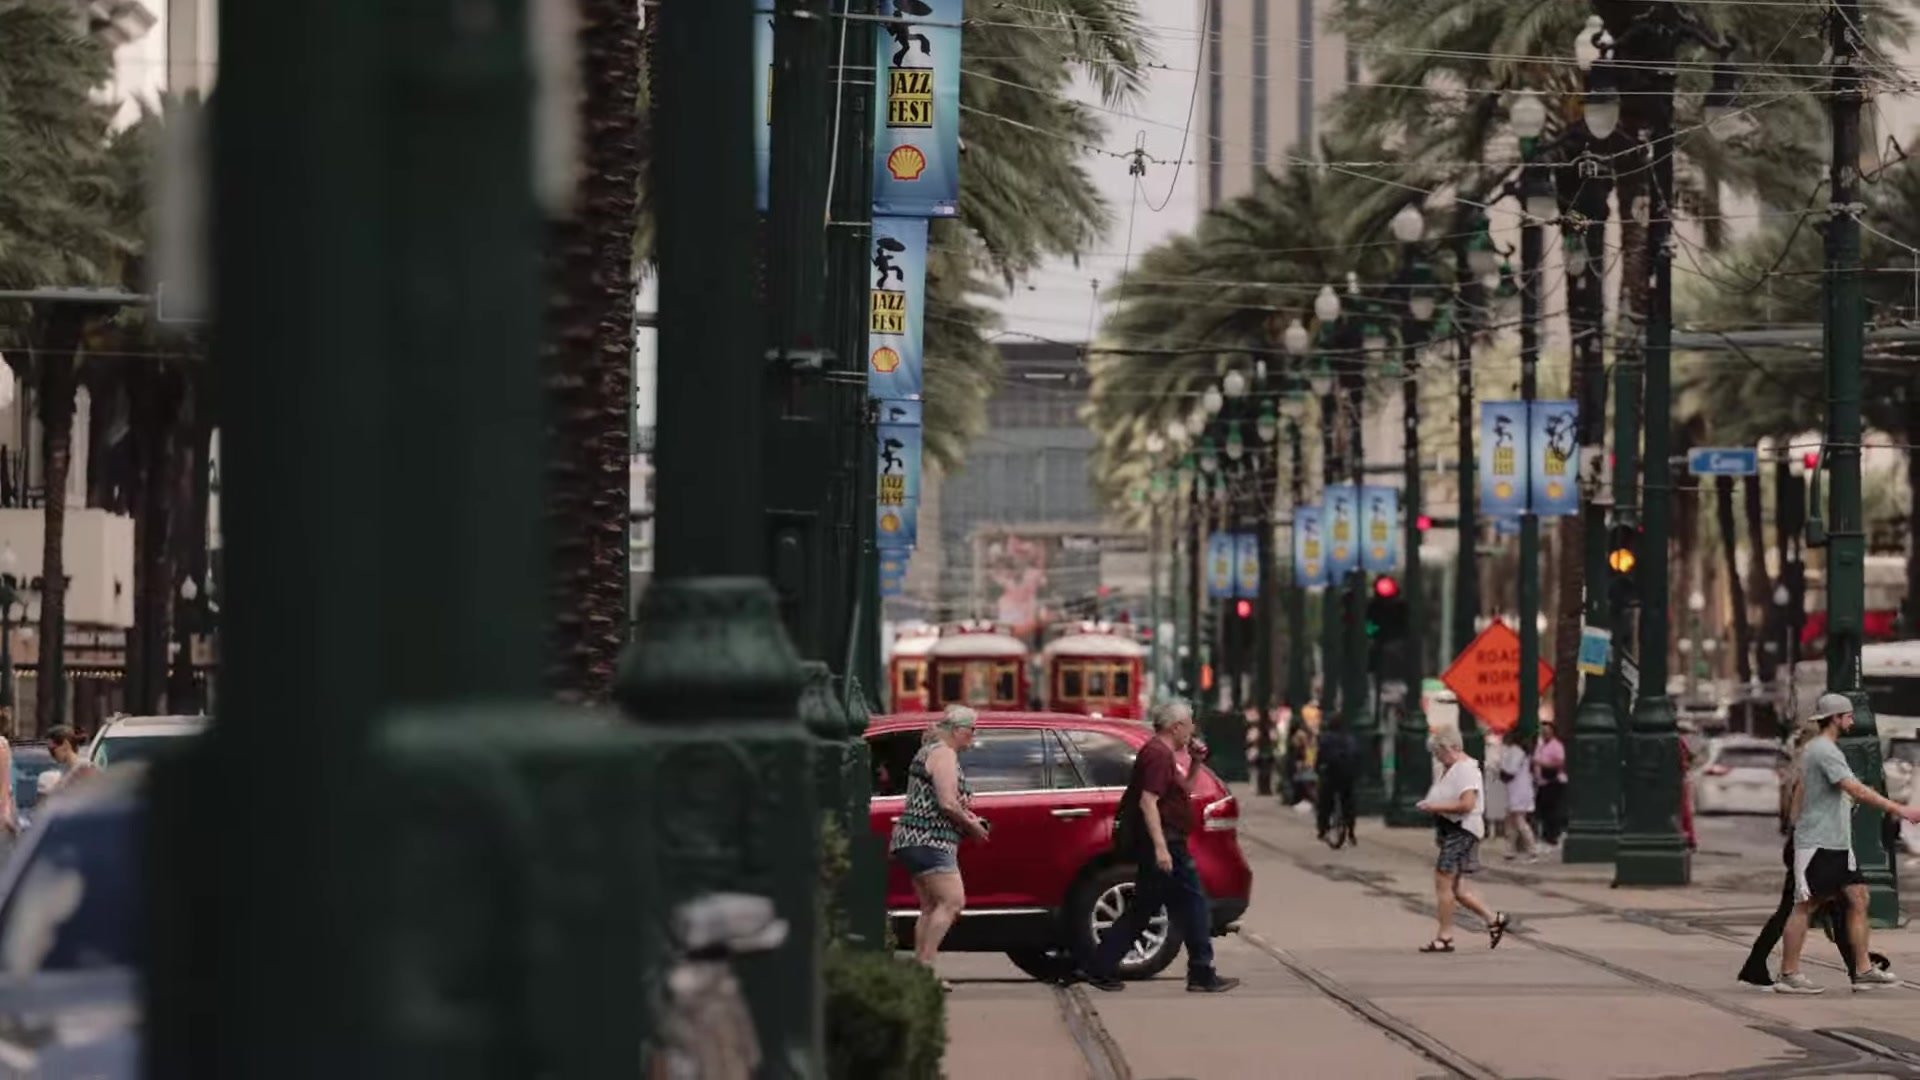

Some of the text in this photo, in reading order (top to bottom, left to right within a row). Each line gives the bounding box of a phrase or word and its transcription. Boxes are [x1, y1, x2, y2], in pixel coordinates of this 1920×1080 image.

[889, 73, 931, 97] JAZZ
[888, 101, 932, 123] FEST
[872, 293, 904, 311] JAZZ
[872, 314, 904, 331] FEST
[1473, 690, 1517, 706] AHEA
